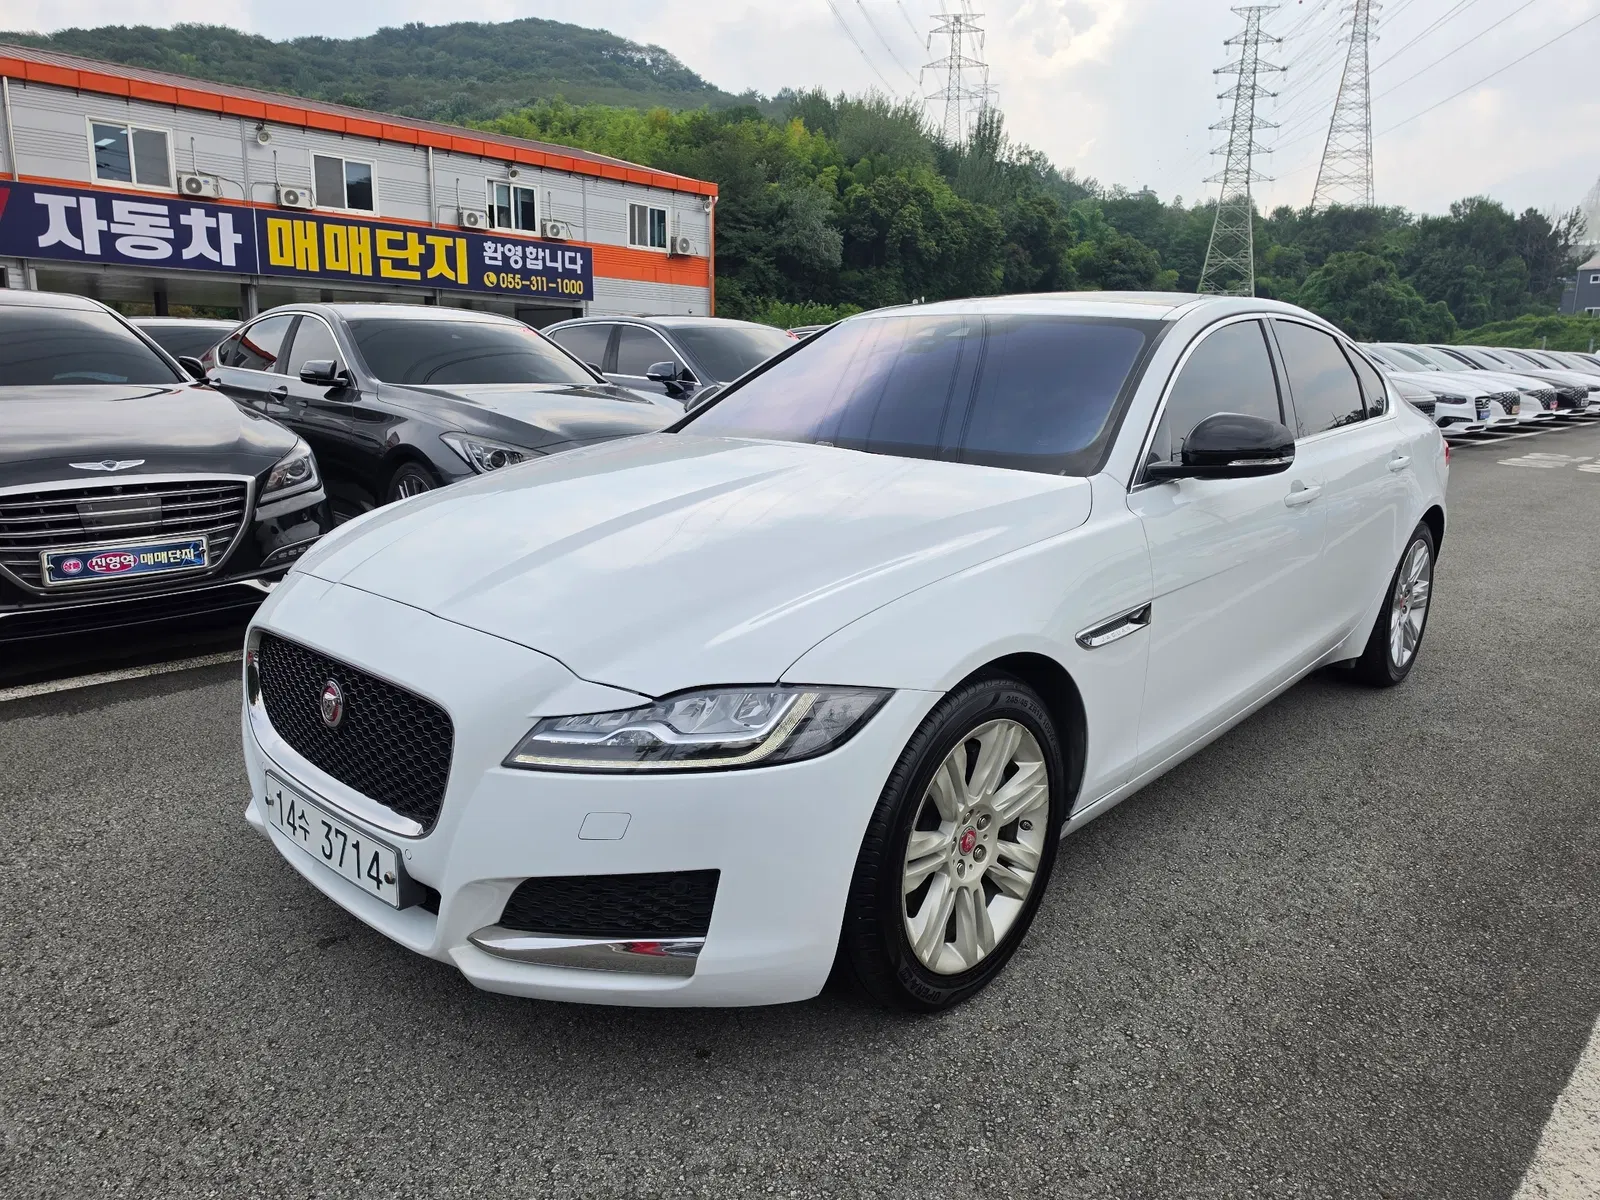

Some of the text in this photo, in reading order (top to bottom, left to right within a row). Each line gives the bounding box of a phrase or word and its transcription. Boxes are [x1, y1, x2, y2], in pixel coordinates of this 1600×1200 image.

[34, 192, 469, 285] 자동차 매매단지
[483, 241, 583, 273] 환영합니다
[499, 273, 584, 295] 055-311-1000
[140, 548, 194, 565] 매매단지
[276, 790, 383, 890] 14수 3714
